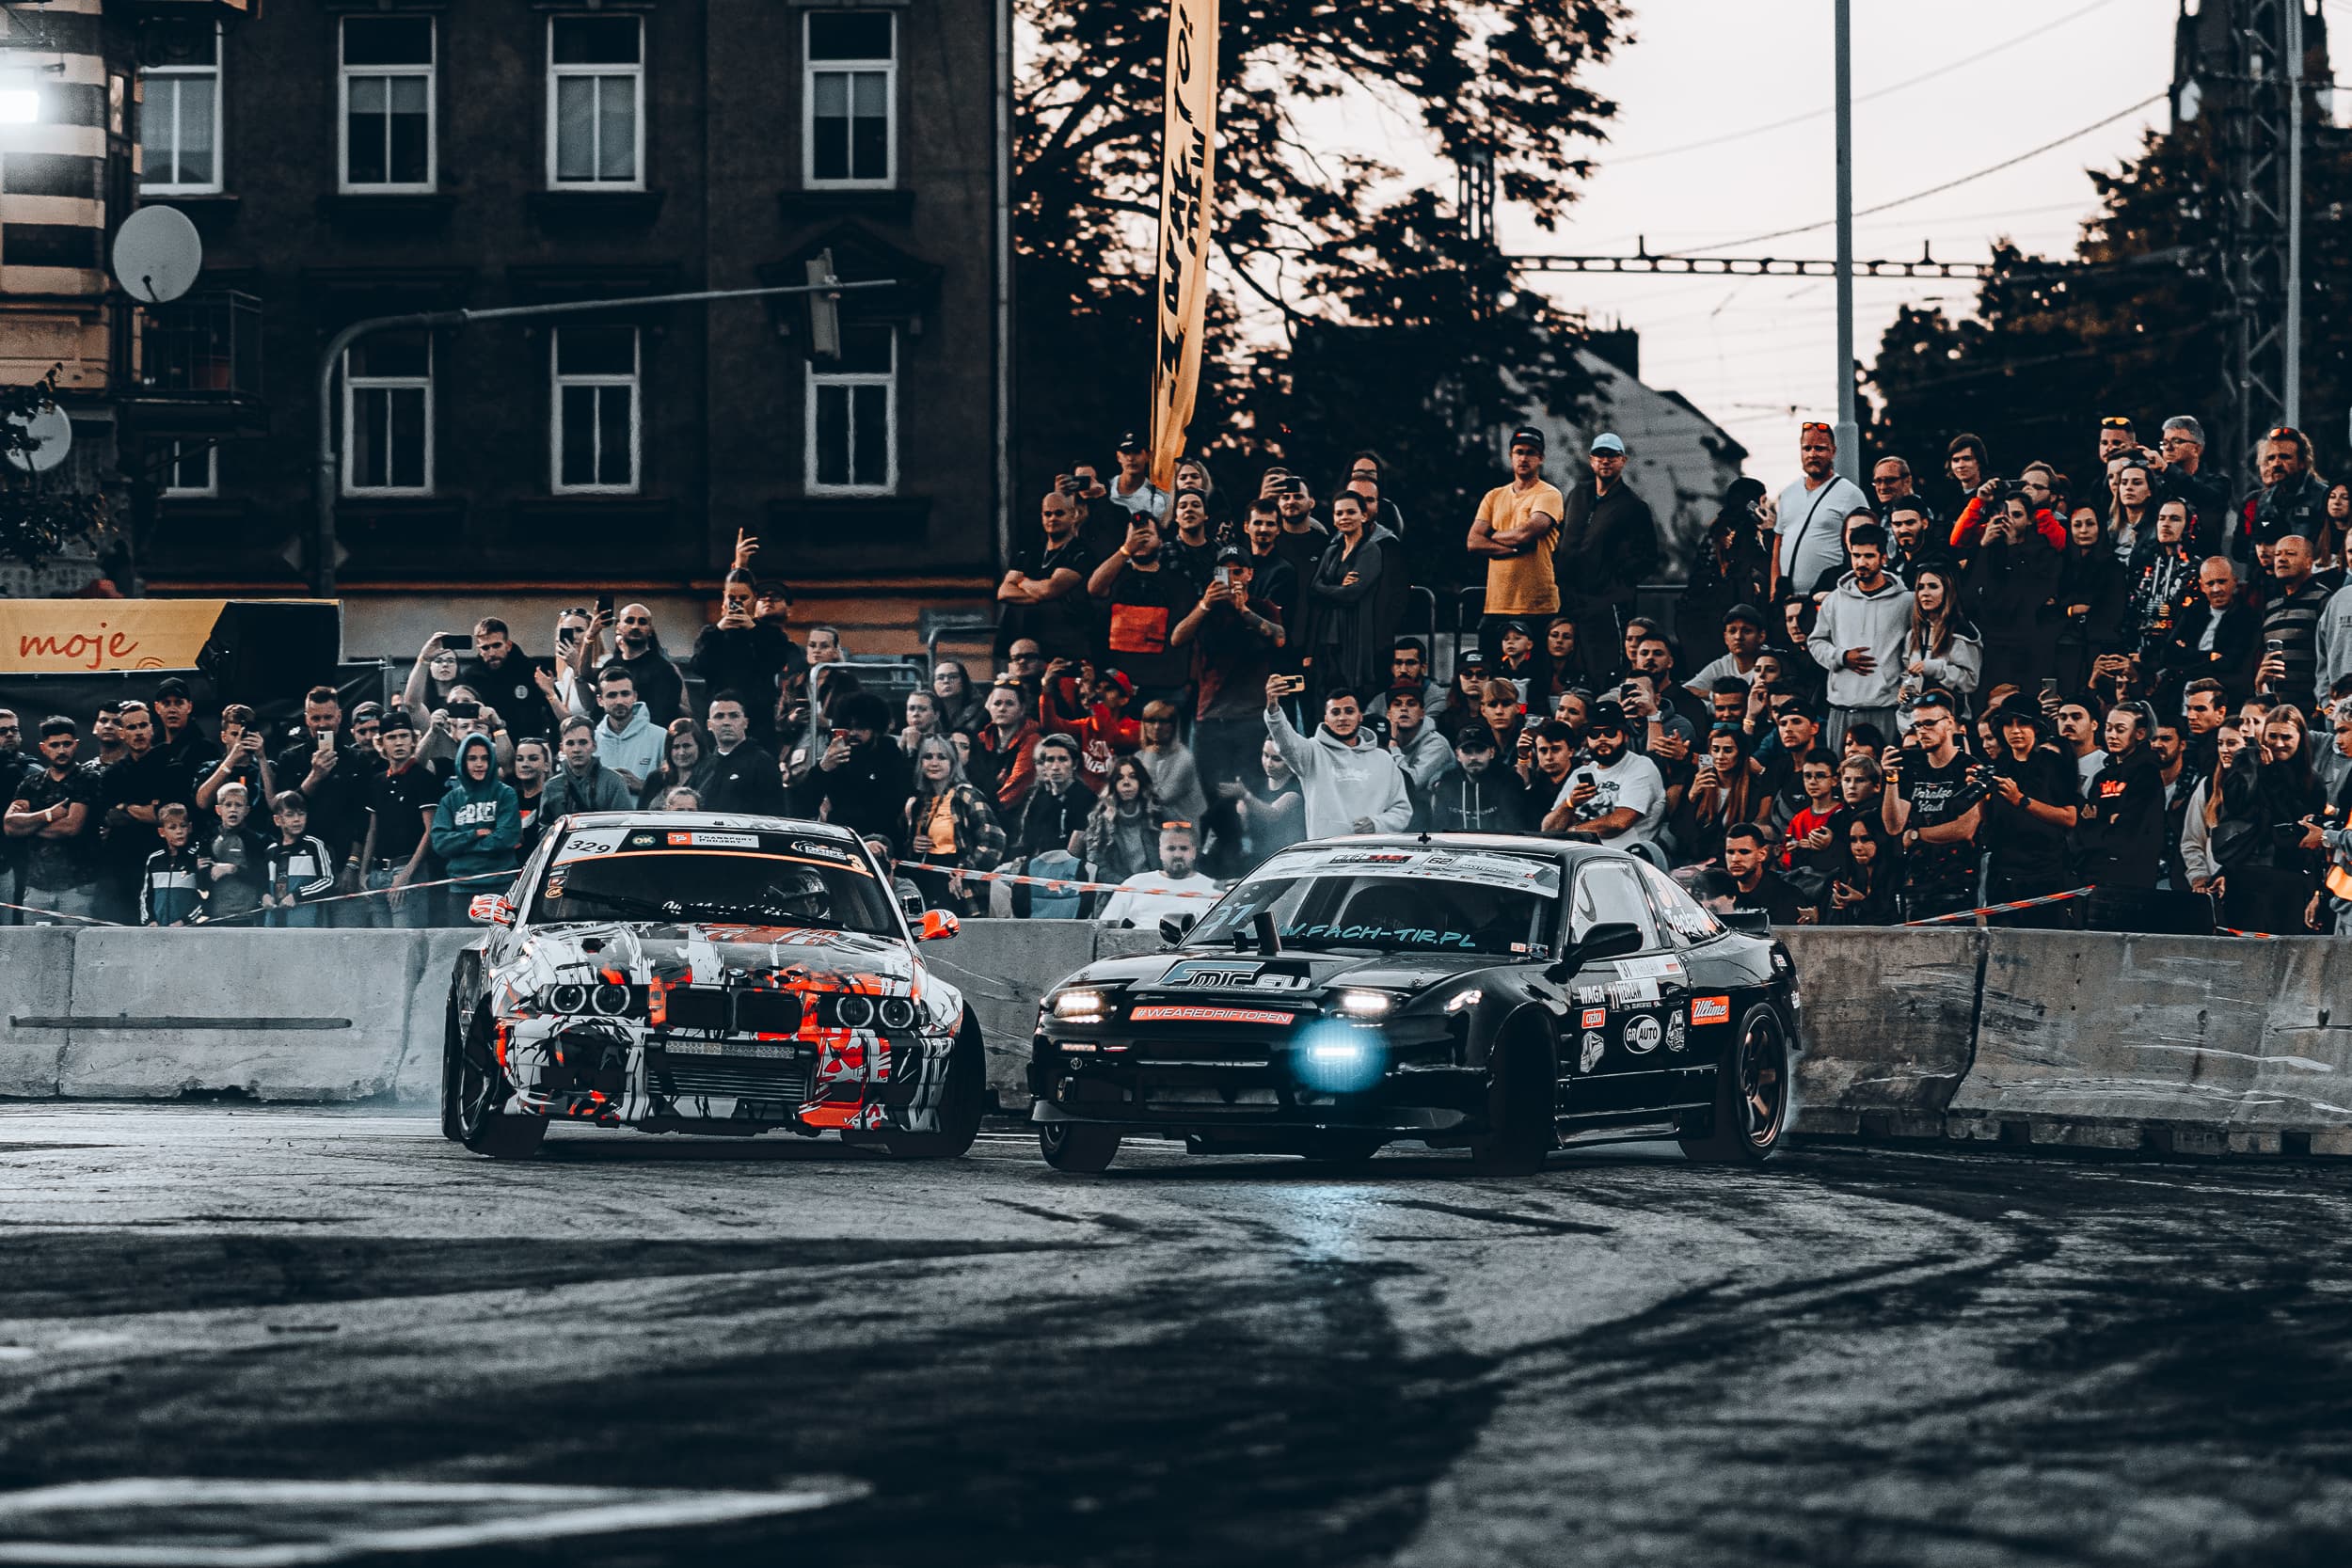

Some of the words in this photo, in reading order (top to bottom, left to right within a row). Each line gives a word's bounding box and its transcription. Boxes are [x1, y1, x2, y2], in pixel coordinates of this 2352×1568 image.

[20, 622, 138, 669] moje
[566, 839, 612, 854] 329
[1579, 985, 1606, 1005] WAGA
[1136, 1007, 1293, 1022] #WEAREDRIFTOPEN
[1626, 1028, 1637, 1042] GR
[1638, 1027, 1659, 1040] AUTO
